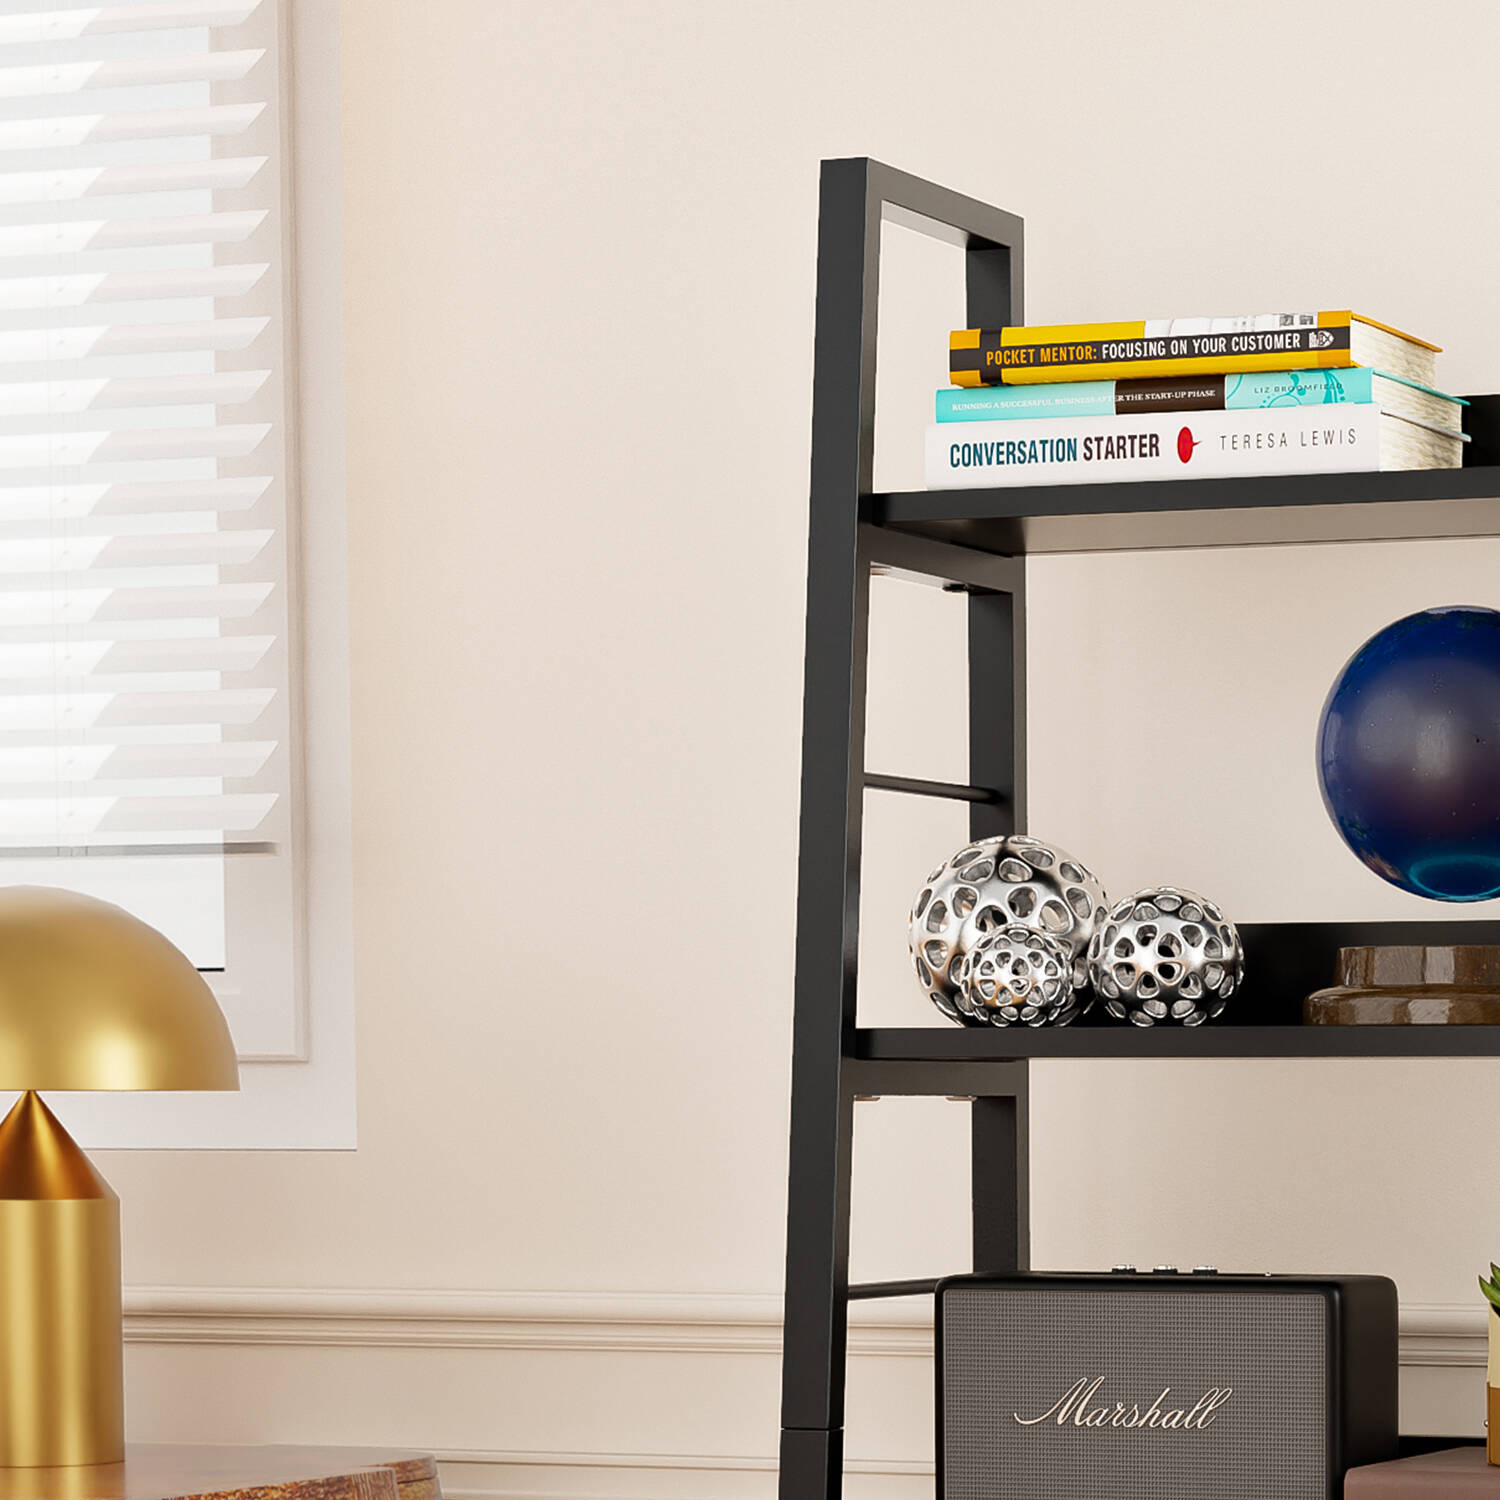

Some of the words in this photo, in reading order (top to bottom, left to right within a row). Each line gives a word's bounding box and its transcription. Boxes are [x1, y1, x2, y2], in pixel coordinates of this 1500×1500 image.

[986, 348, 1035, 366] POCKET
[1040, 345, 1097, 363] MENTOR:
[1102, 340, 1166, 359] FOCUSING
[1170, 339, 1187, 355] ON
[1192, 337, 1226, 354] YOUR
[1232, 333, 1301, 351] CUSTOMER
[952, 401, 992, 411] RUNNING
[993, 401, 1000, 409] A
[1000, 398, 1051, 408] SUCCESSFUL
[1125, 392, 1142, 401] THE
[1144, 389, 1186, 400] START-UP
[1187, 388, 1216, 398] PHASE
[1254, 386, 1269, 395] LIZ
[1274, 383, 1343, 393] BROOMFIELD
[950, 437, 1077, 468] CONVERSATION
[1083, 433, 1161, 461] STARTER
[1220, 431, 1287, 450] TERESA
[1300, 428, 1357, 447] LEWIS
[1014, 1376, 1232, 1429] Marshall
